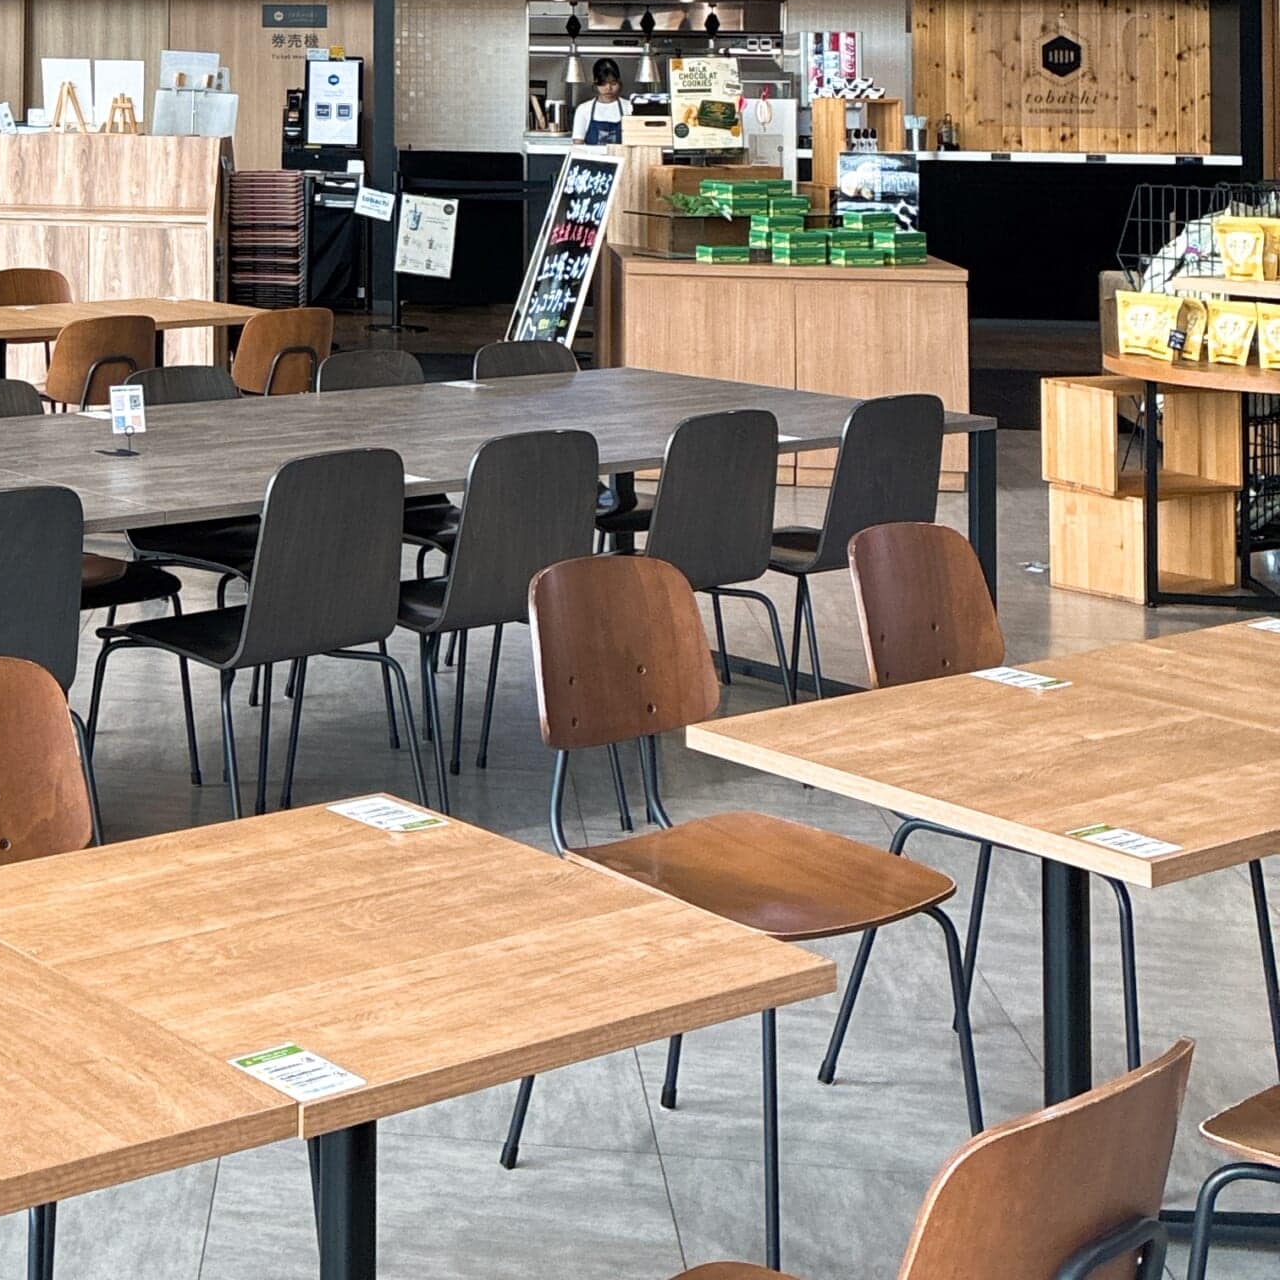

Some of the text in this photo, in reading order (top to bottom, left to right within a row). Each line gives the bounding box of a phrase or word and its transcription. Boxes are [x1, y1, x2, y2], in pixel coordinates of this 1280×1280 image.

[271, 32, 320, 48] 券売機
[682, 79, 713, 88] COOKIES
